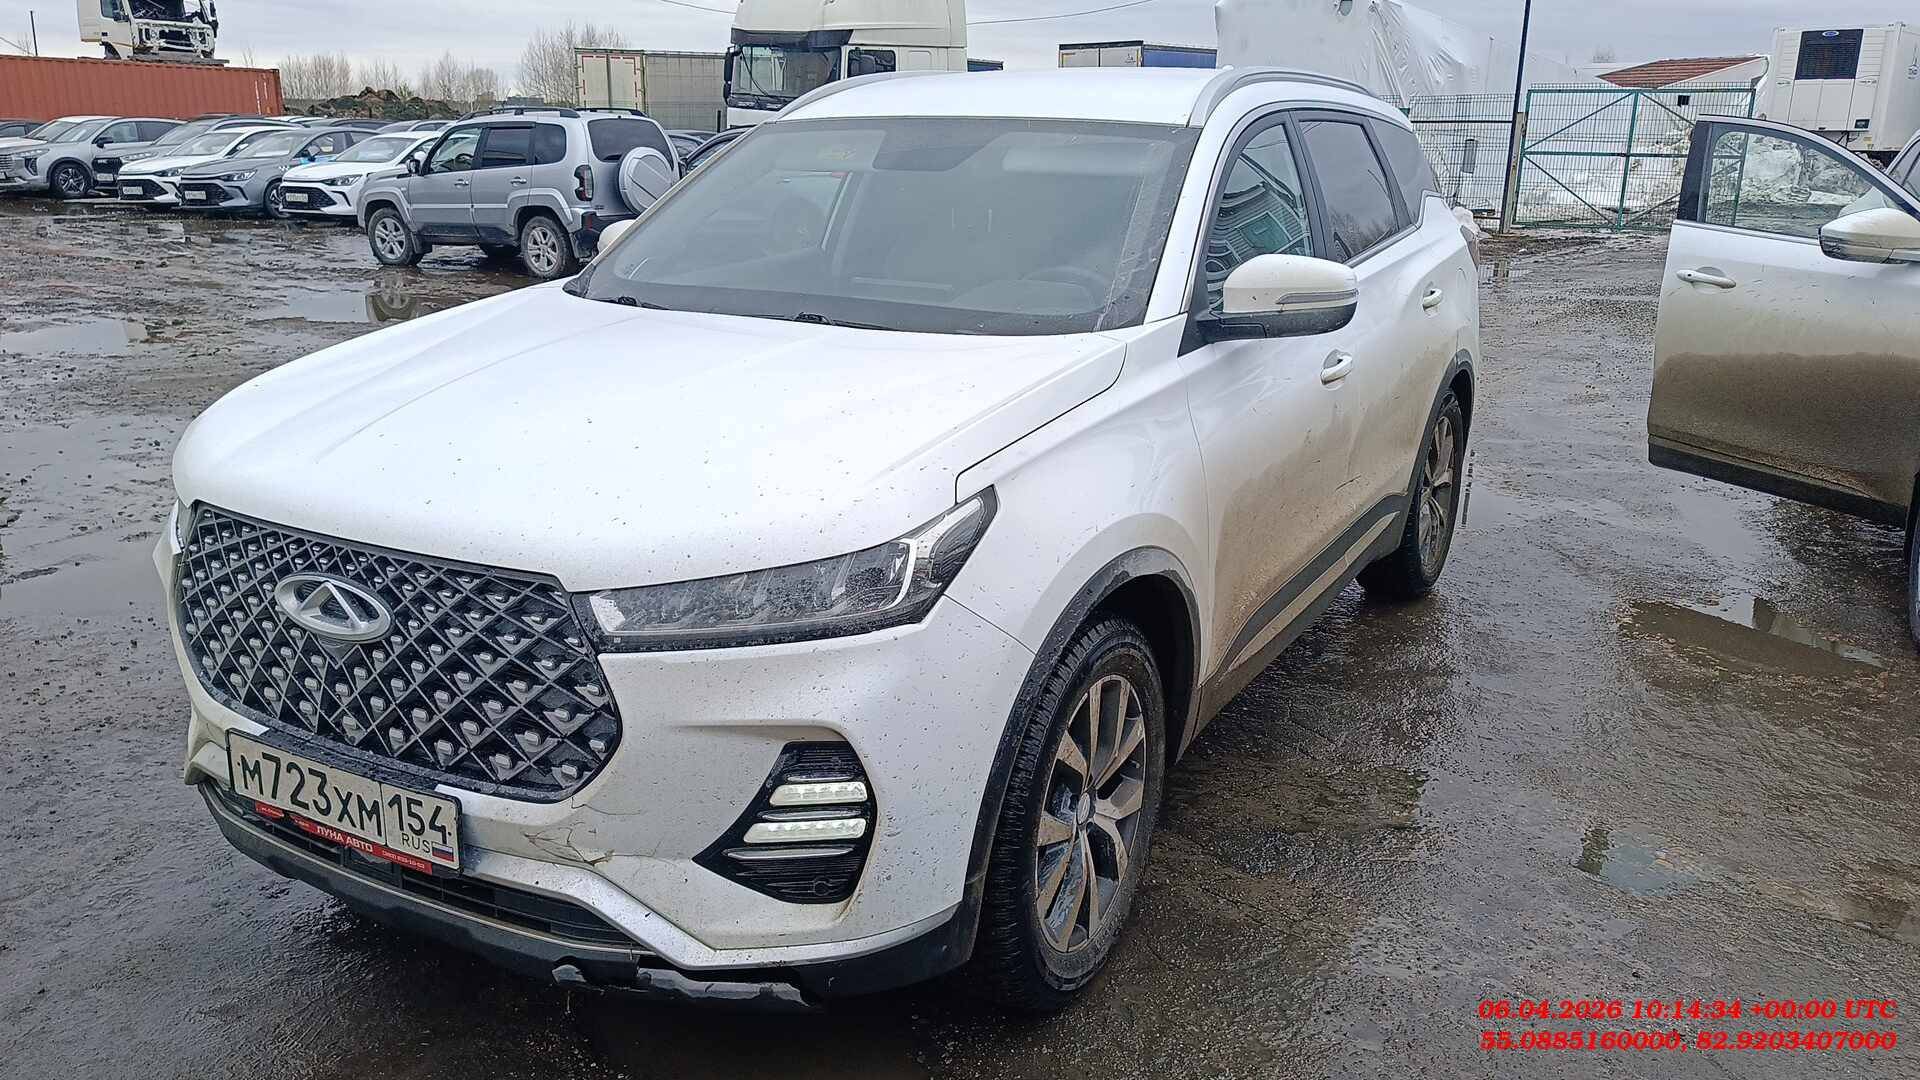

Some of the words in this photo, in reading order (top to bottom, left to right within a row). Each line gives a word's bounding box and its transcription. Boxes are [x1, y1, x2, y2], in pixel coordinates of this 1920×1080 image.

[240, 752, 383, 837] М723ХМ
[388, 793, 449, 844] 154
[345, 836, 373, 853] АВТО
[401, 832, 431, 854] RUS
